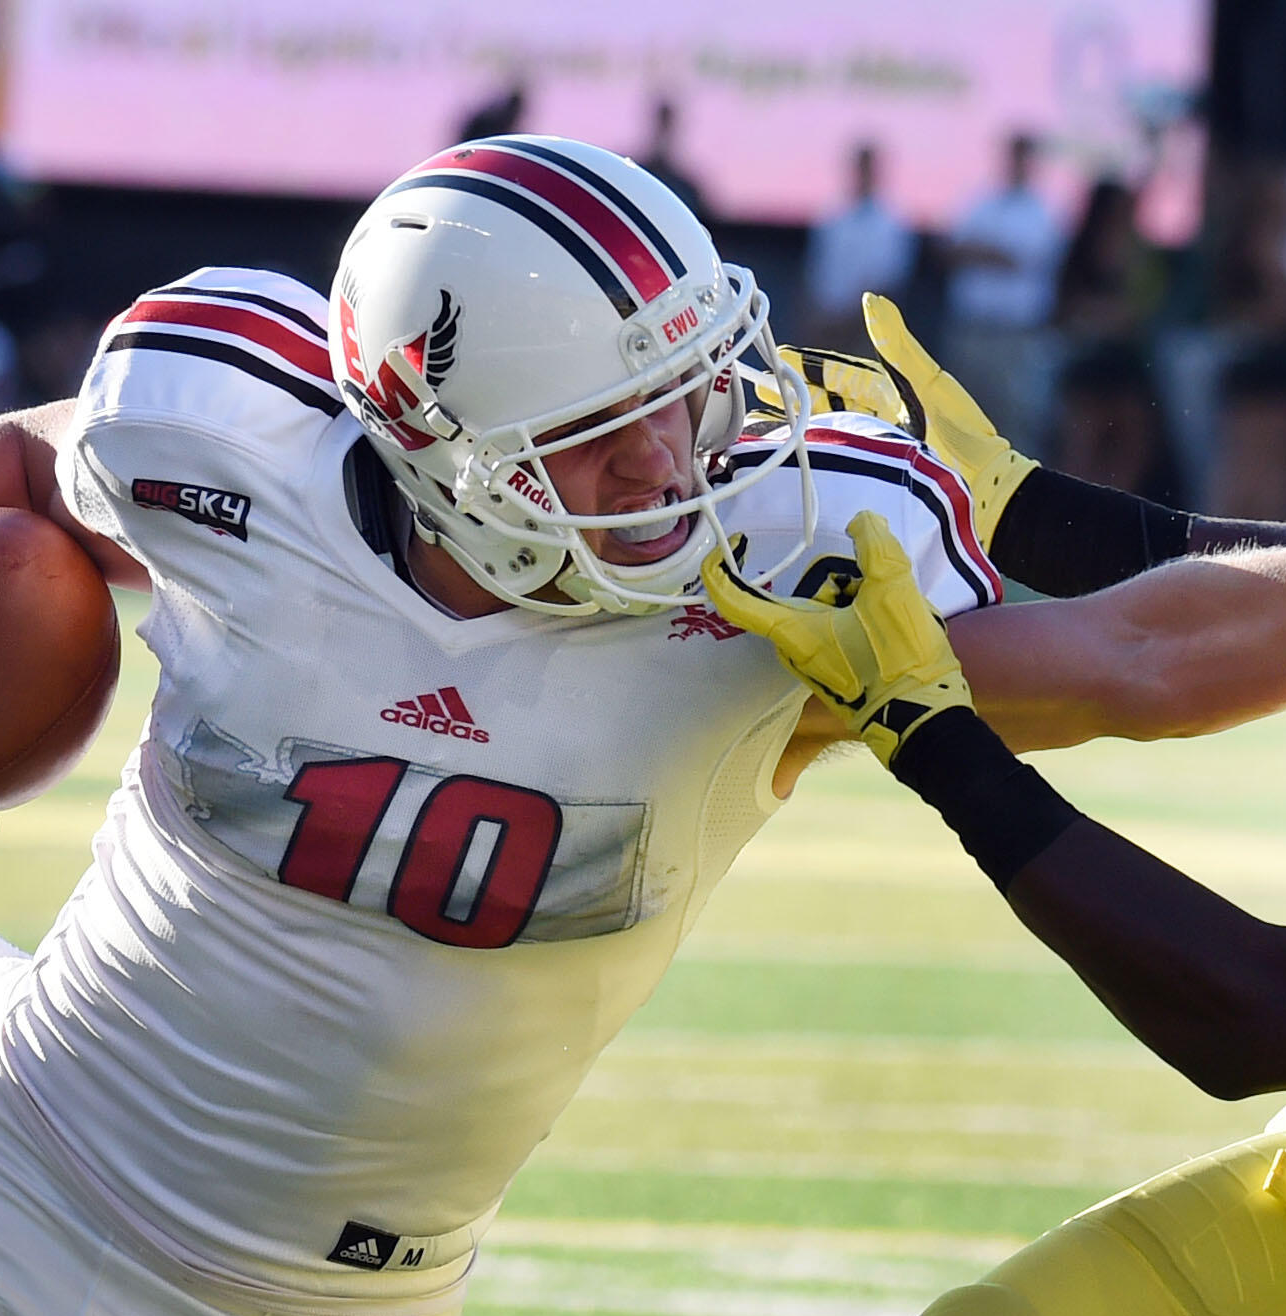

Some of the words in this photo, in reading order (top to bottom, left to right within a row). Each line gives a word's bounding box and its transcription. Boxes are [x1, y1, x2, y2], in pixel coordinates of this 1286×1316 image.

[661, 306, 699, 344] EWU
[507, 470, 554, 514] Ridd
[379, 708, 490, 743] adidas
[277, 756, 563, 949] 10
[339, 1249, 383, 1266] adidas
[400, 1247, 425, 1267] M
